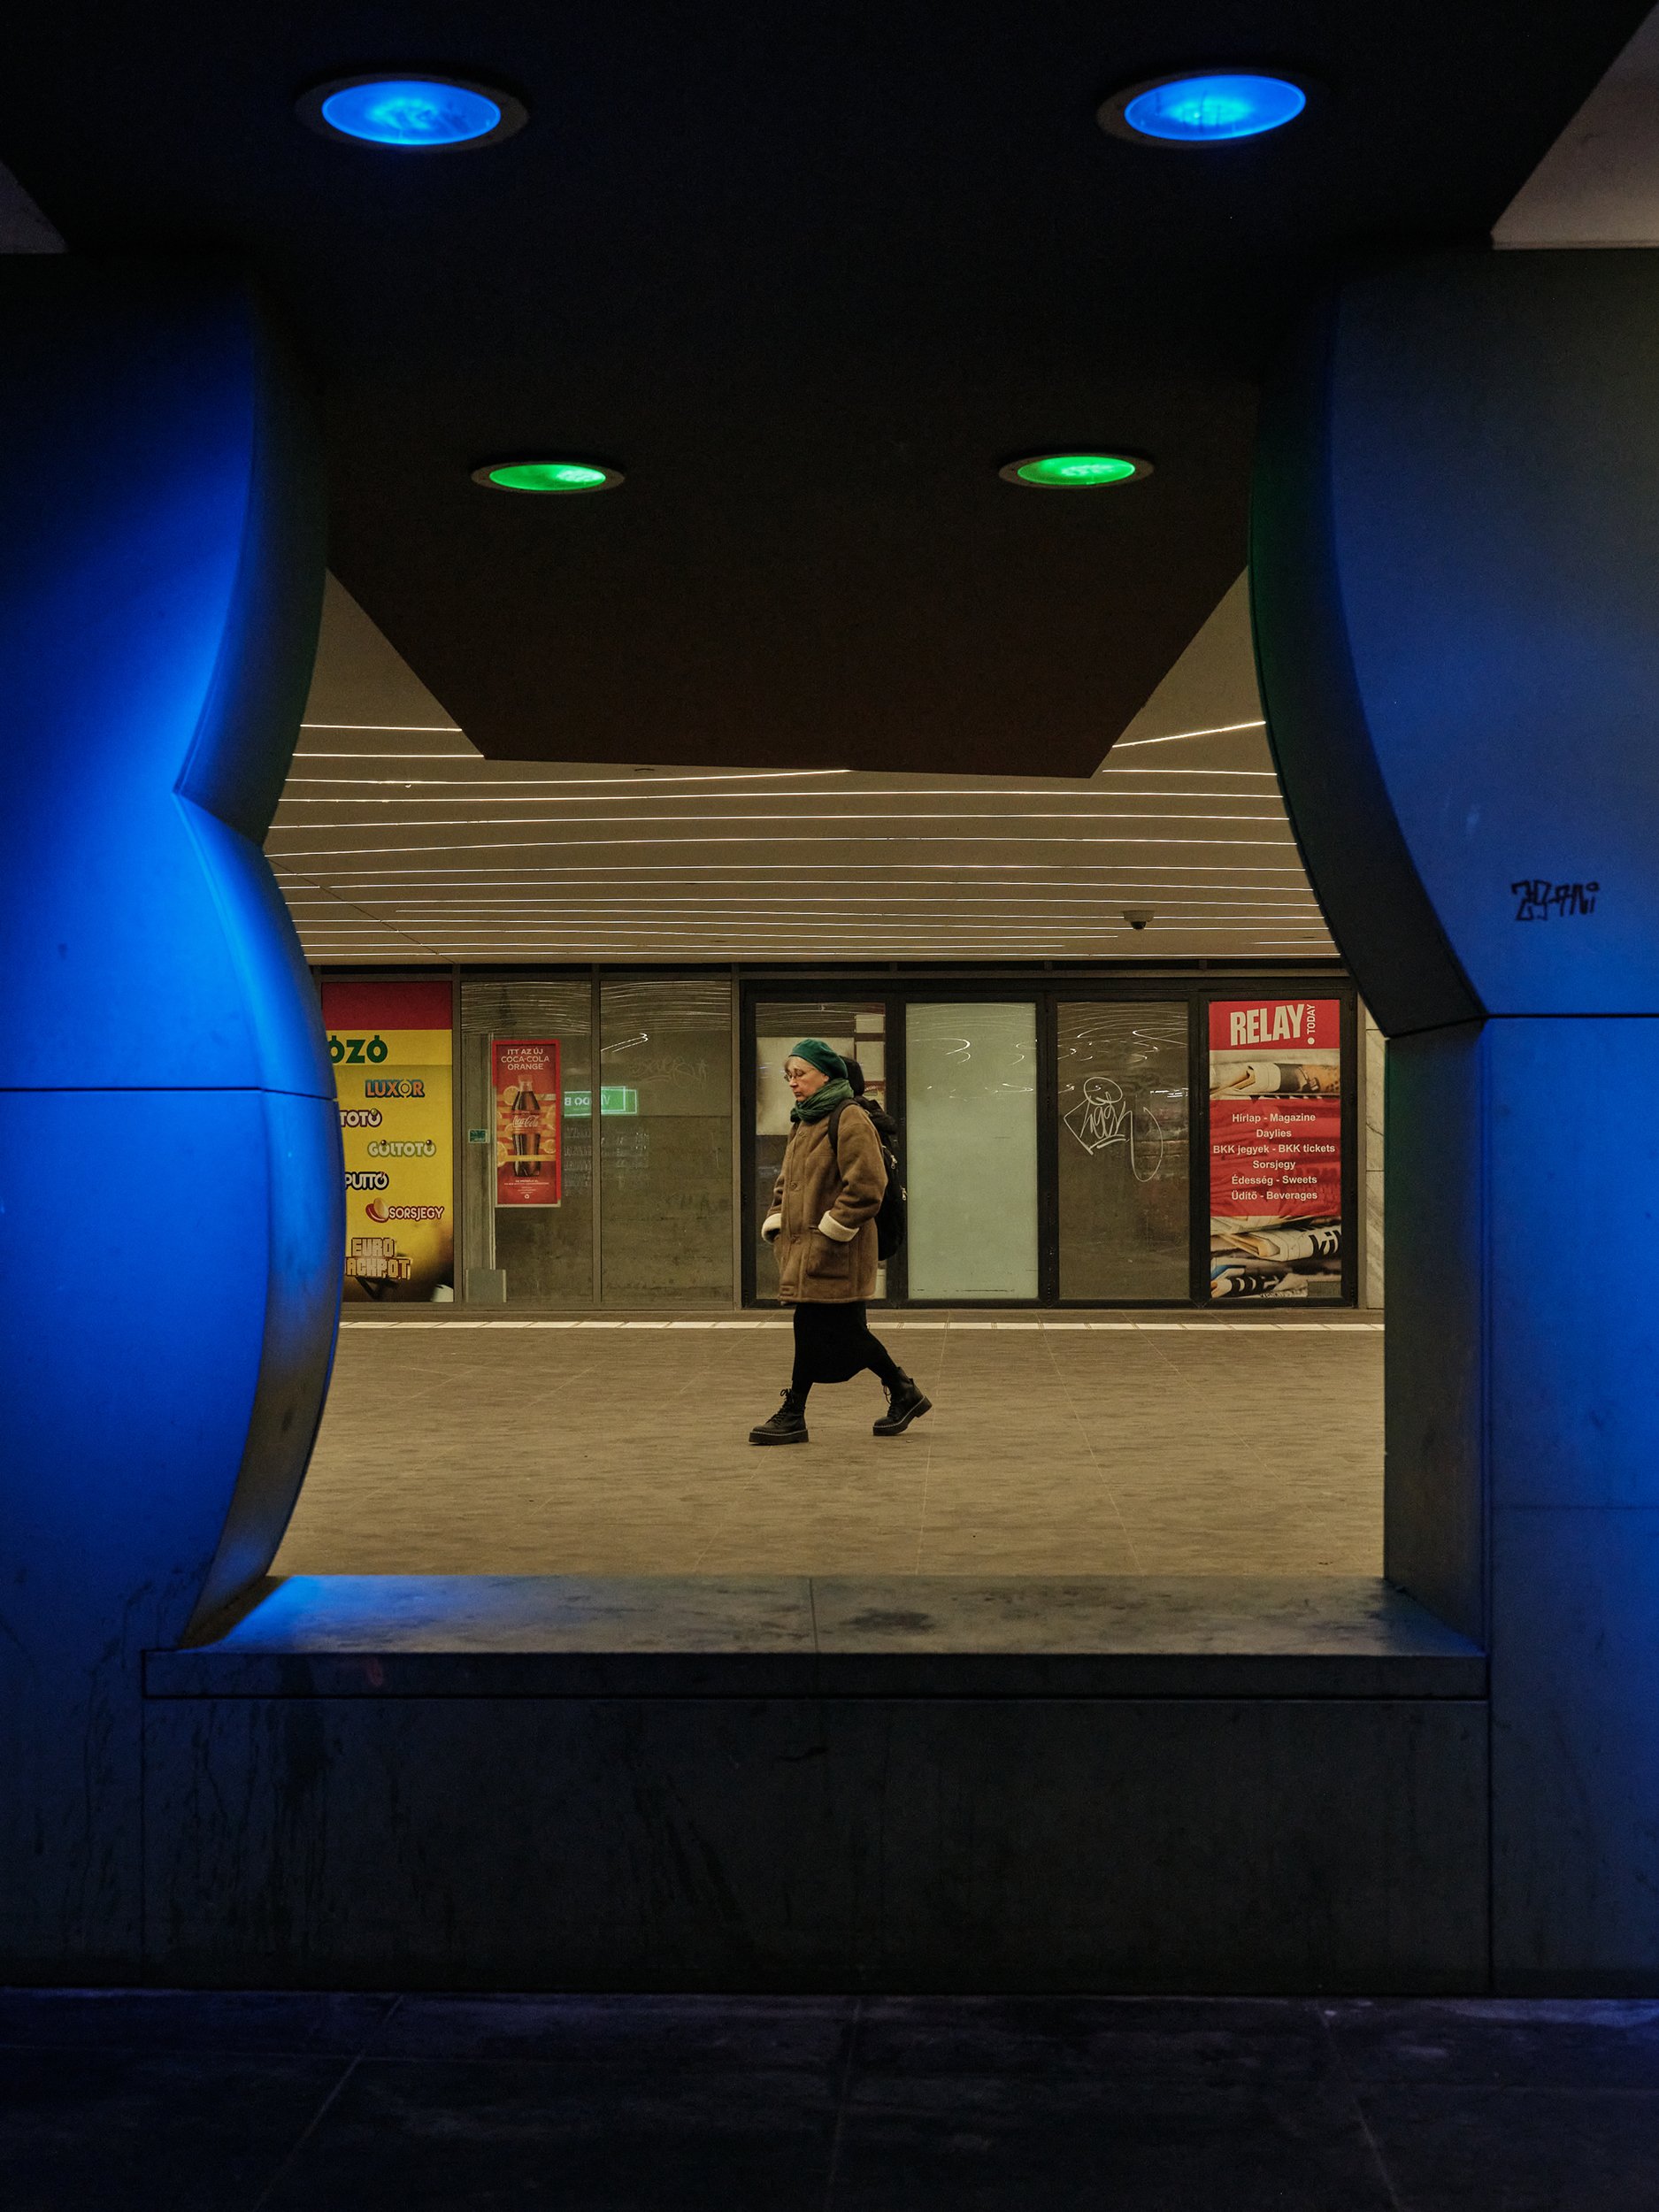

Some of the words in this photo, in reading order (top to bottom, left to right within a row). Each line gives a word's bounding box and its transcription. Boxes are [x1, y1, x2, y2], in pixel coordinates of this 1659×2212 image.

[1230, 1003, 1305, 1046] RELAY
[1306, 1004, 1316, 1034] TODAY
[365, 1079, 425, 1097] LUXOR
[1232, 1114, 1261, 1123] Hírlap
[1270, 1113, 1316, 1123] Magazine
[1256, 1129, 1292, 1139] Daylies
[1213, 1145, 1235, 1154] BKK
[1237, 1145, 1270, 1155] jegyek
[1279, 1144, 1301, 1153] BKK
[1302, 1144, 1336, 1153] tickets
[1253, 1160, 1296, 1170] Sorsjegy
[1232, 1174, 1273, 1186] Édesség
[1282, 1175, 1317, 1184] Sweets
[1266, 1191, 1317, 1201] Beverages
[388, 1206, 444, 1221] SORSJEGY
[351, 1238, 395, 1256] EURO
[345, 1256, 411, 1279] ACKPOT
